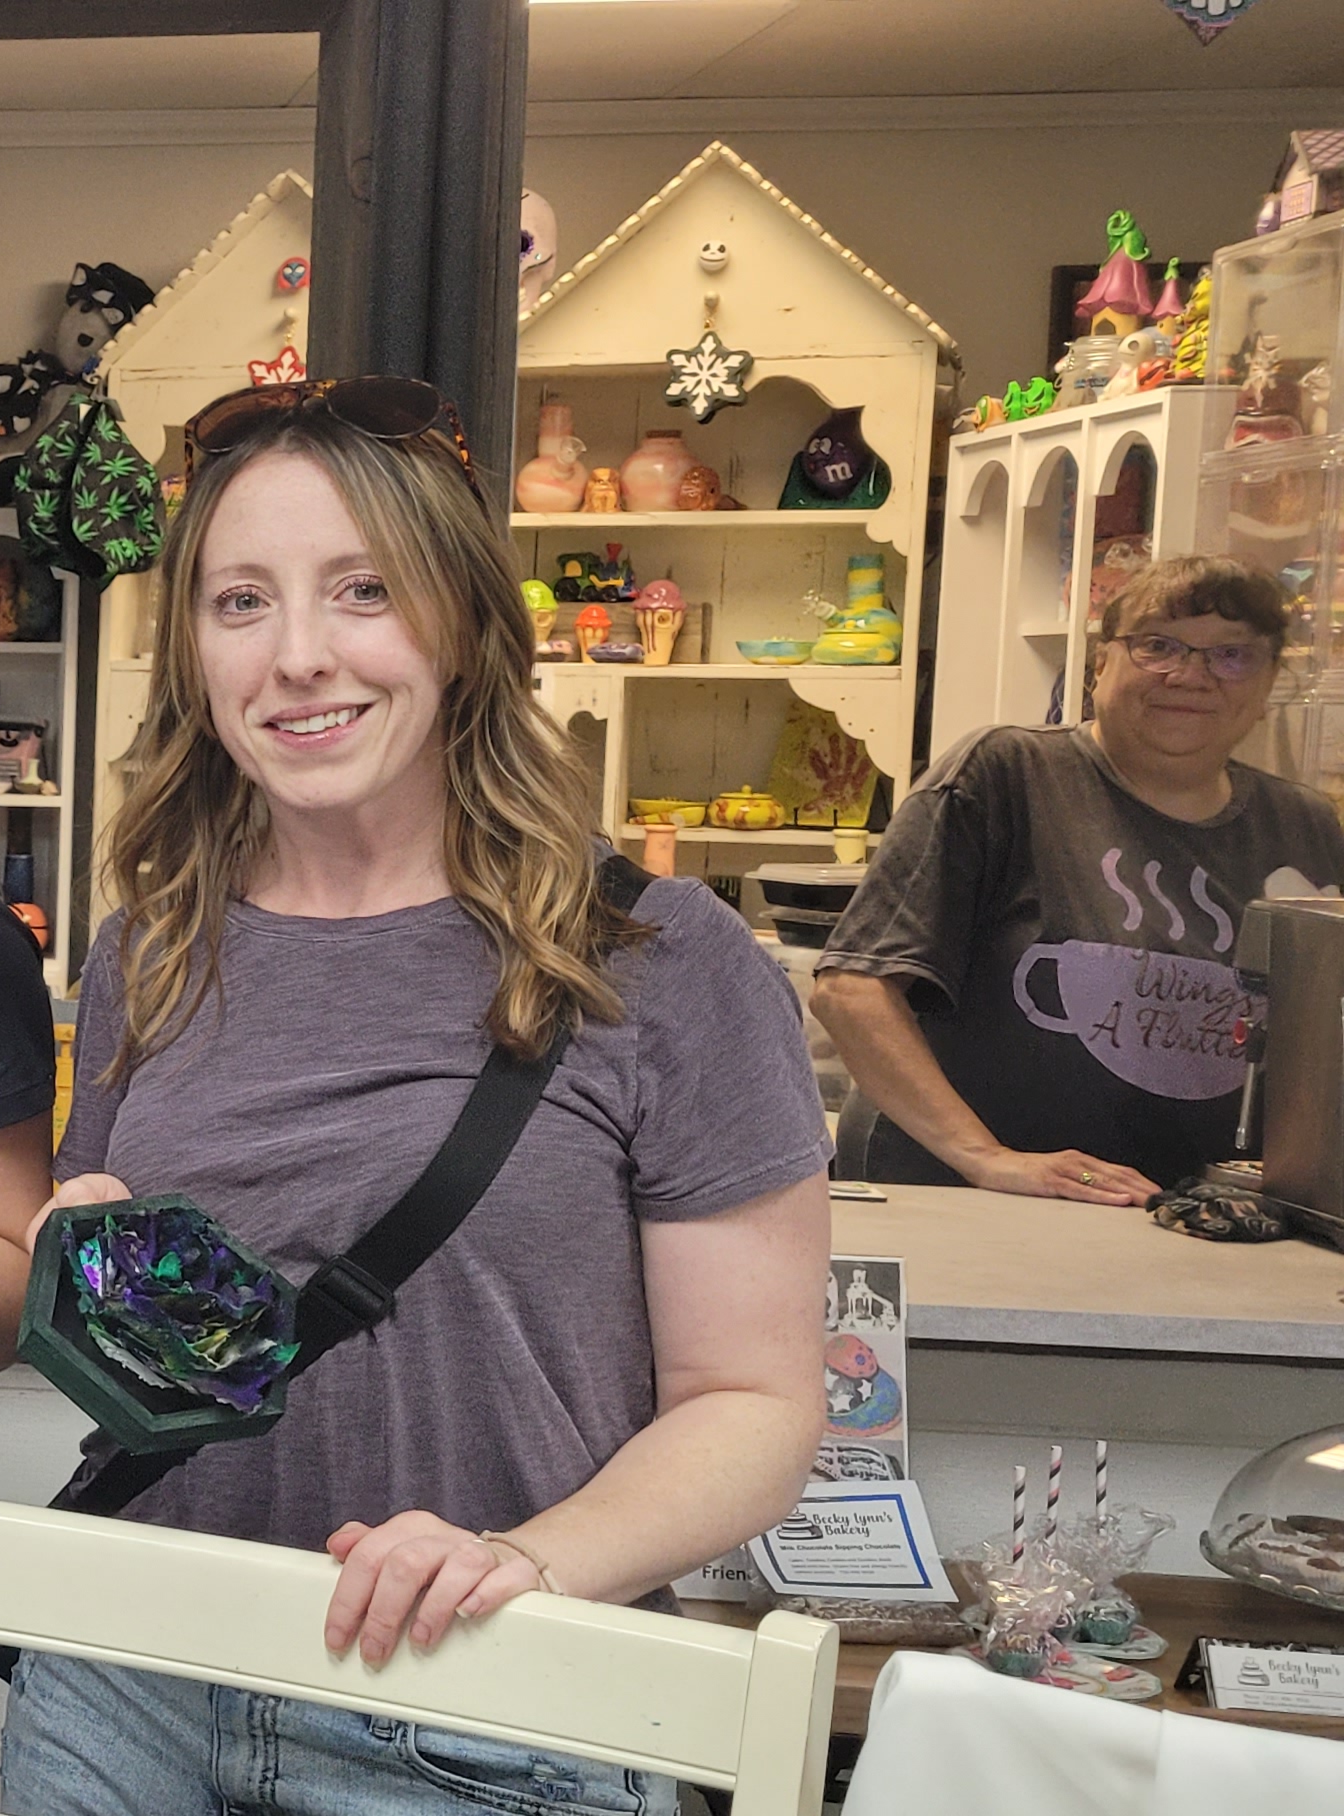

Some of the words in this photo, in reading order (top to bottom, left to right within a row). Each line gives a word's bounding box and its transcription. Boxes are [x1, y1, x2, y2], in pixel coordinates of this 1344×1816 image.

[1132, 950, 1252, 1028] Wings
[1088, 1001, 1123, 1049] A
[1137, 1006, 1247, 1059] Flutte
[812, 1513, 850, 1527] Becky
[824, 1524, 871, 1538] Bakery
[702, 1565, 751, 1581] Frien
[1268, 1659, 1302, 1674] Becky
[1279, 1673, 1320, 1689] Bakery
